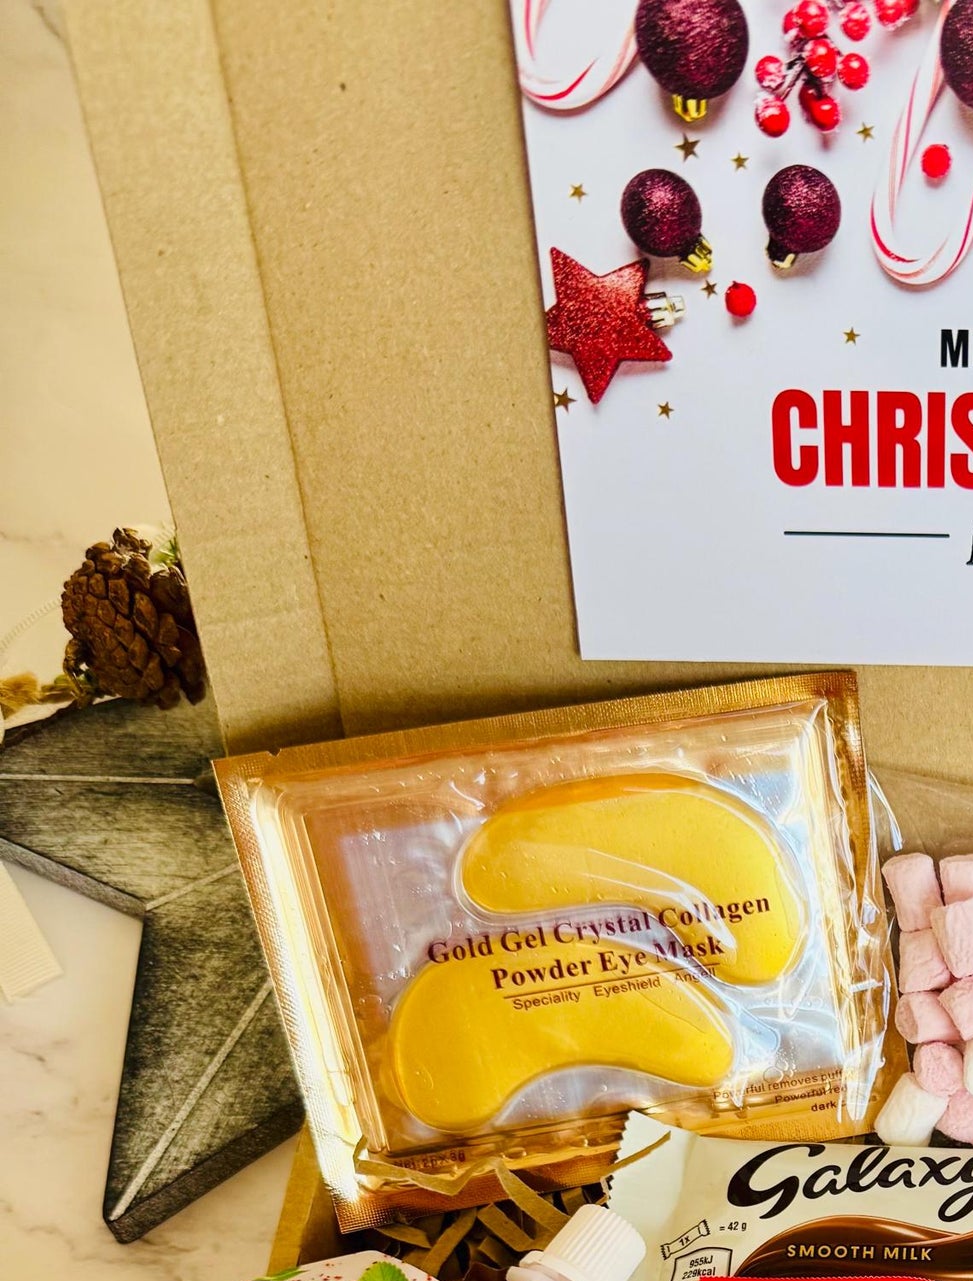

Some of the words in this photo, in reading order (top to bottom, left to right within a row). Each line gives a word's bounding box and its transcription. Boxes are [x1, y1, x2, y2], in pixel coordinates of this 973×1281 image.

[427, 934, 494, 965] Gold
[501, 925, 547, 954] Gel
[553, 912, 651, 945] Crystal
[658, 897, 770, 928] Collagen
[491, 955, 593, 990] Powder
[600, 949, 648, 976] Eye
[653, 935, 724, 963] Mask
[512, 989, 581, 1012] Speciality
[594, 975, 661, 998] Eyeshield
[768, 1074, 818, 1090] removes
[811, 1102, 837, 1112] dark
[727, 1221, 739, 1231] 42
[741, 1222, 747, 1232] g
[679, 1235, 691, 1247] 1x
[787, 1244, 875, 1260] SMOOTH
[883, 1246, 933, 1261] MILK
[689, 1255, 714, 1269] 955kJ
[682, 1267, 716, 1280] 229kcal
